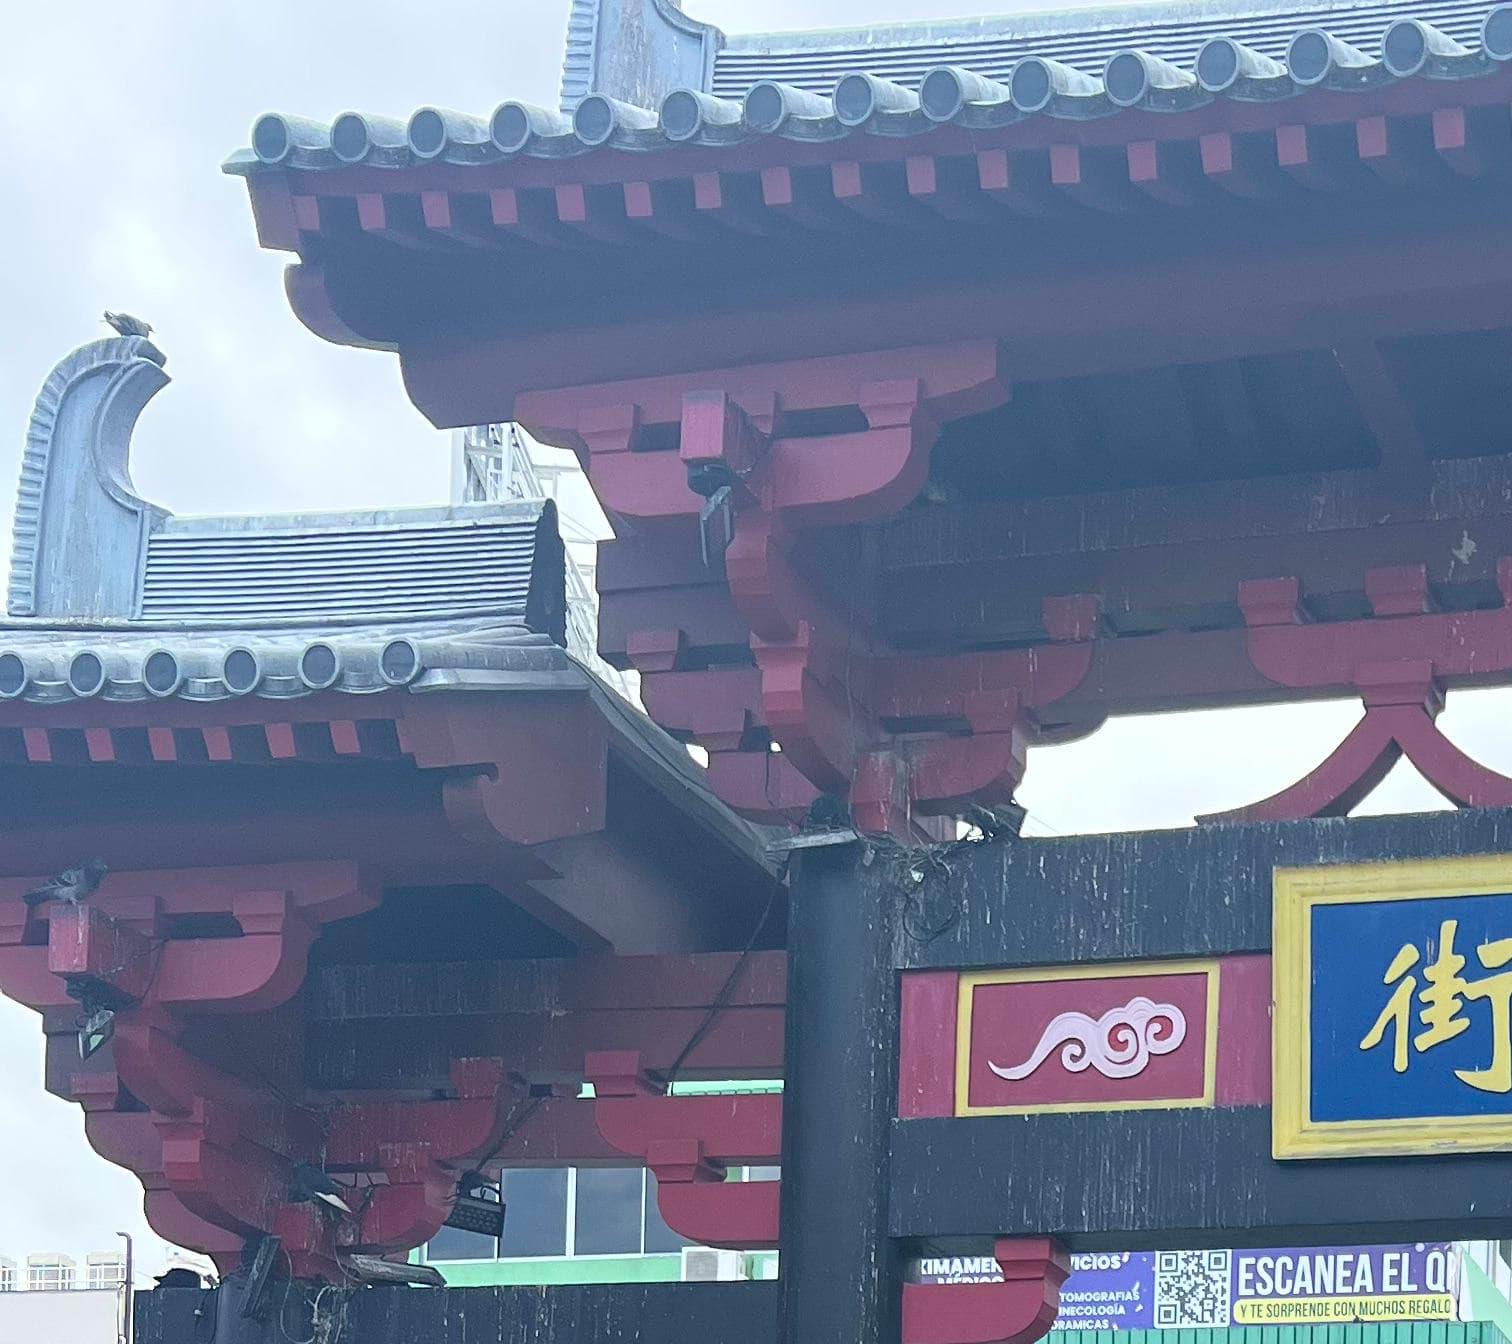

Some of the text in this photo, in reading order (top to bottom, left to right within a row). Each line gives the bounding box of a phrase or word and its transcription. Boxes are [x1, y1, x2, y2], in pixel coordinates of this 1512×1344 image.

[1238, 1254, 1374, 1296] ESCANEA
[1382, 1252, 1418, 1292] EL
[1240, 1304, 1248, 1316] Y
[1250, 1303, 1263, 1318] TE
[1266, 1302, 1330, 1318] SORPRENDE
[1333, 1301, 1356, 1316] CON
[1359, 1299, 1405, 1315] MUCHOS
